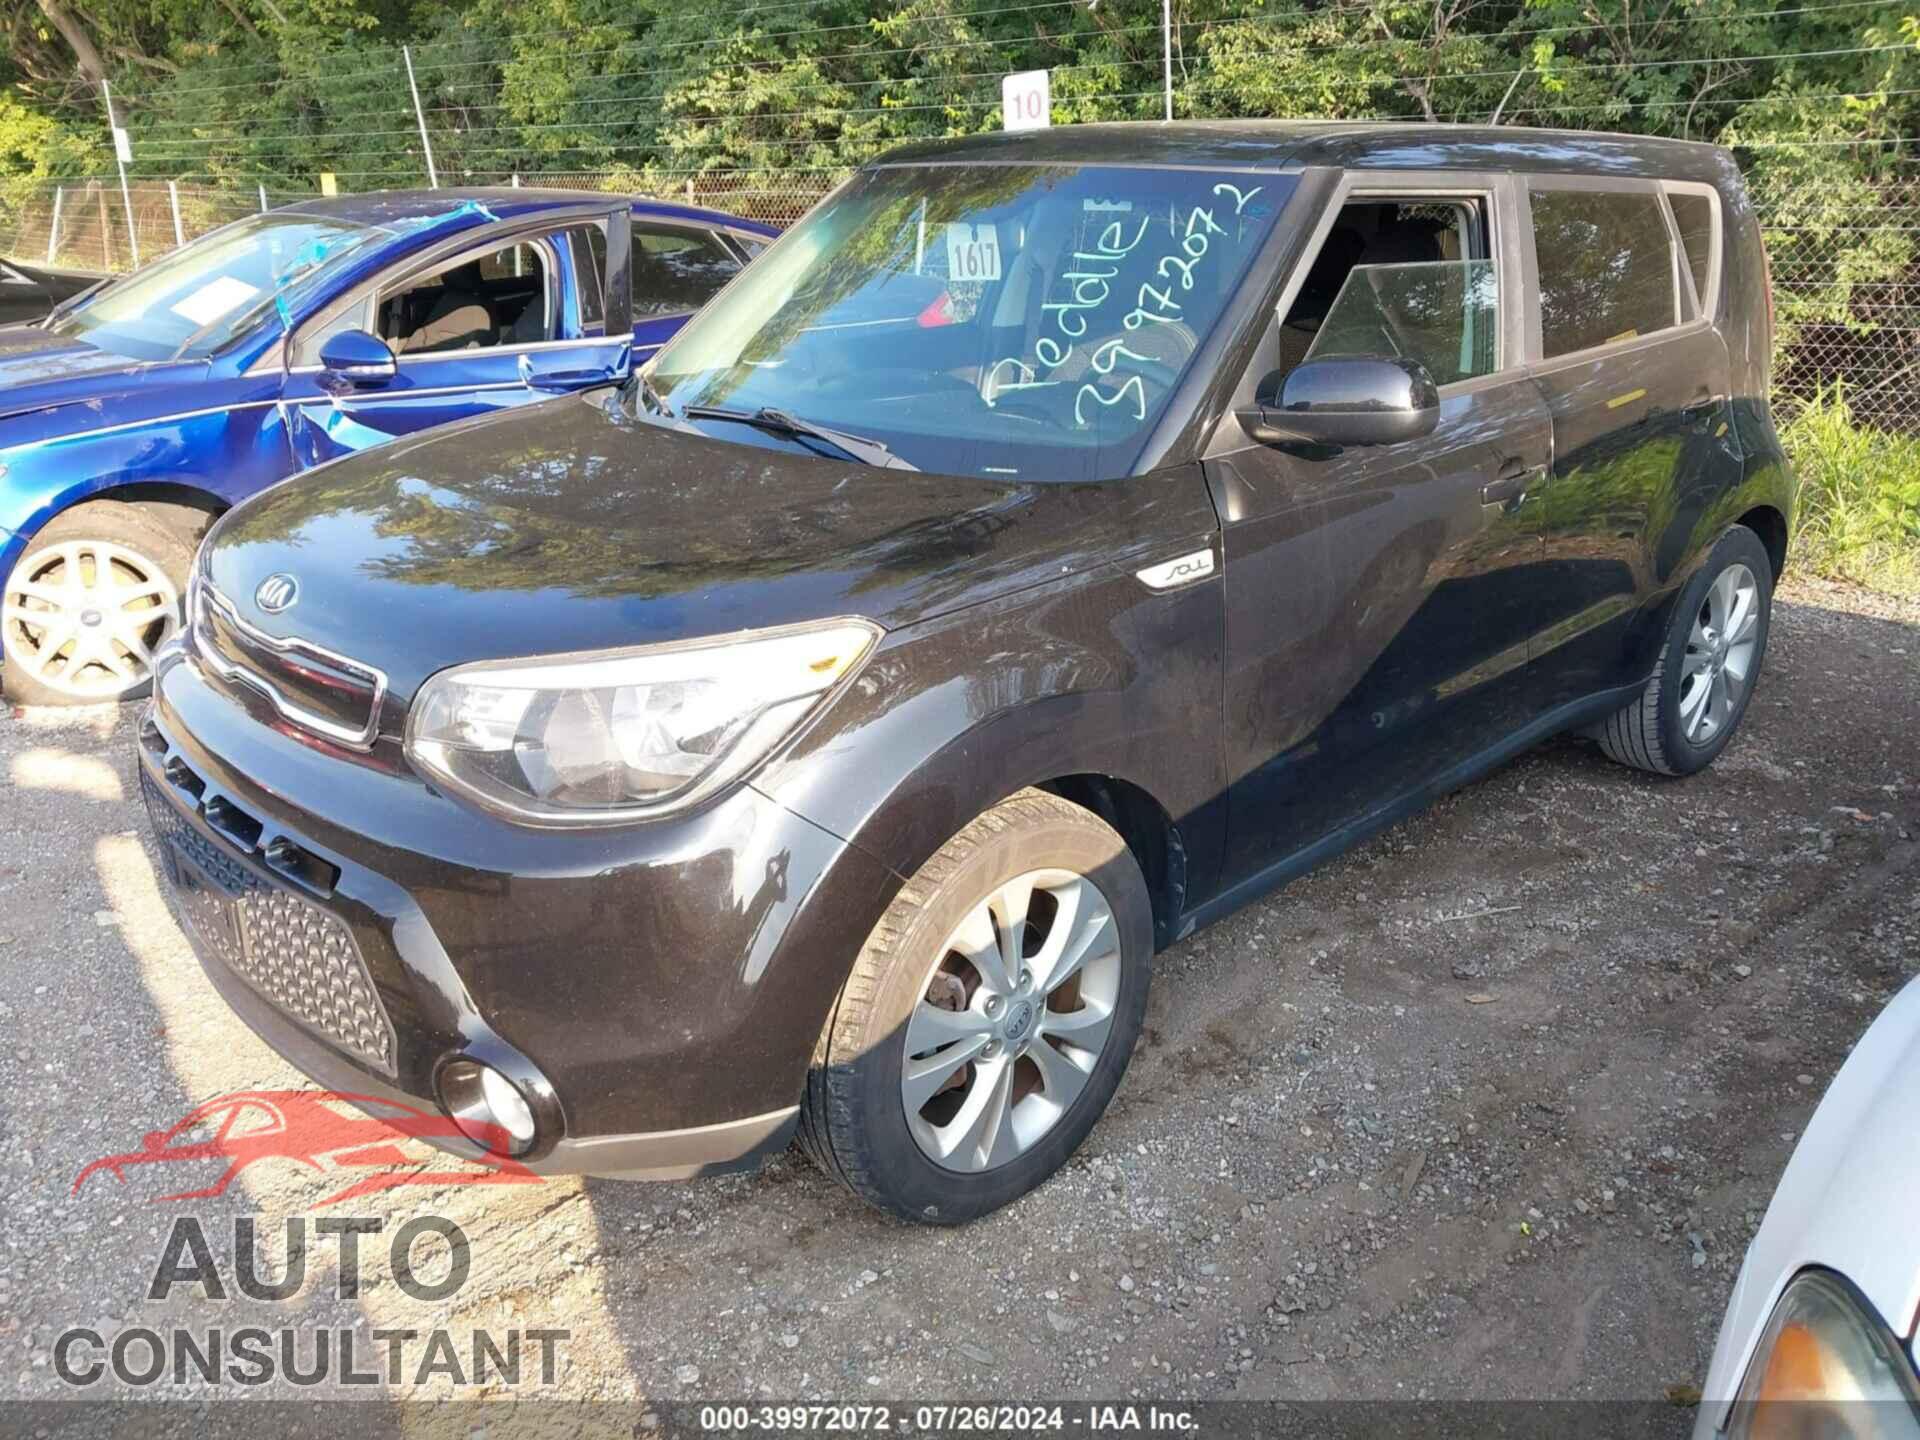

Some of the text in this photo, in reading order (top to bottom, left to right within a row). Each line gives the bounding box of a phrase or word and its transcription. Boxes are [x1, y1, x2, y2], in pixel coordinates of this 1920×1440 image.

[1013, 89, 1041, 119] 10
[955, 242, 994, 276] 1617
[1075, 183, 1263, 425] 39972072
